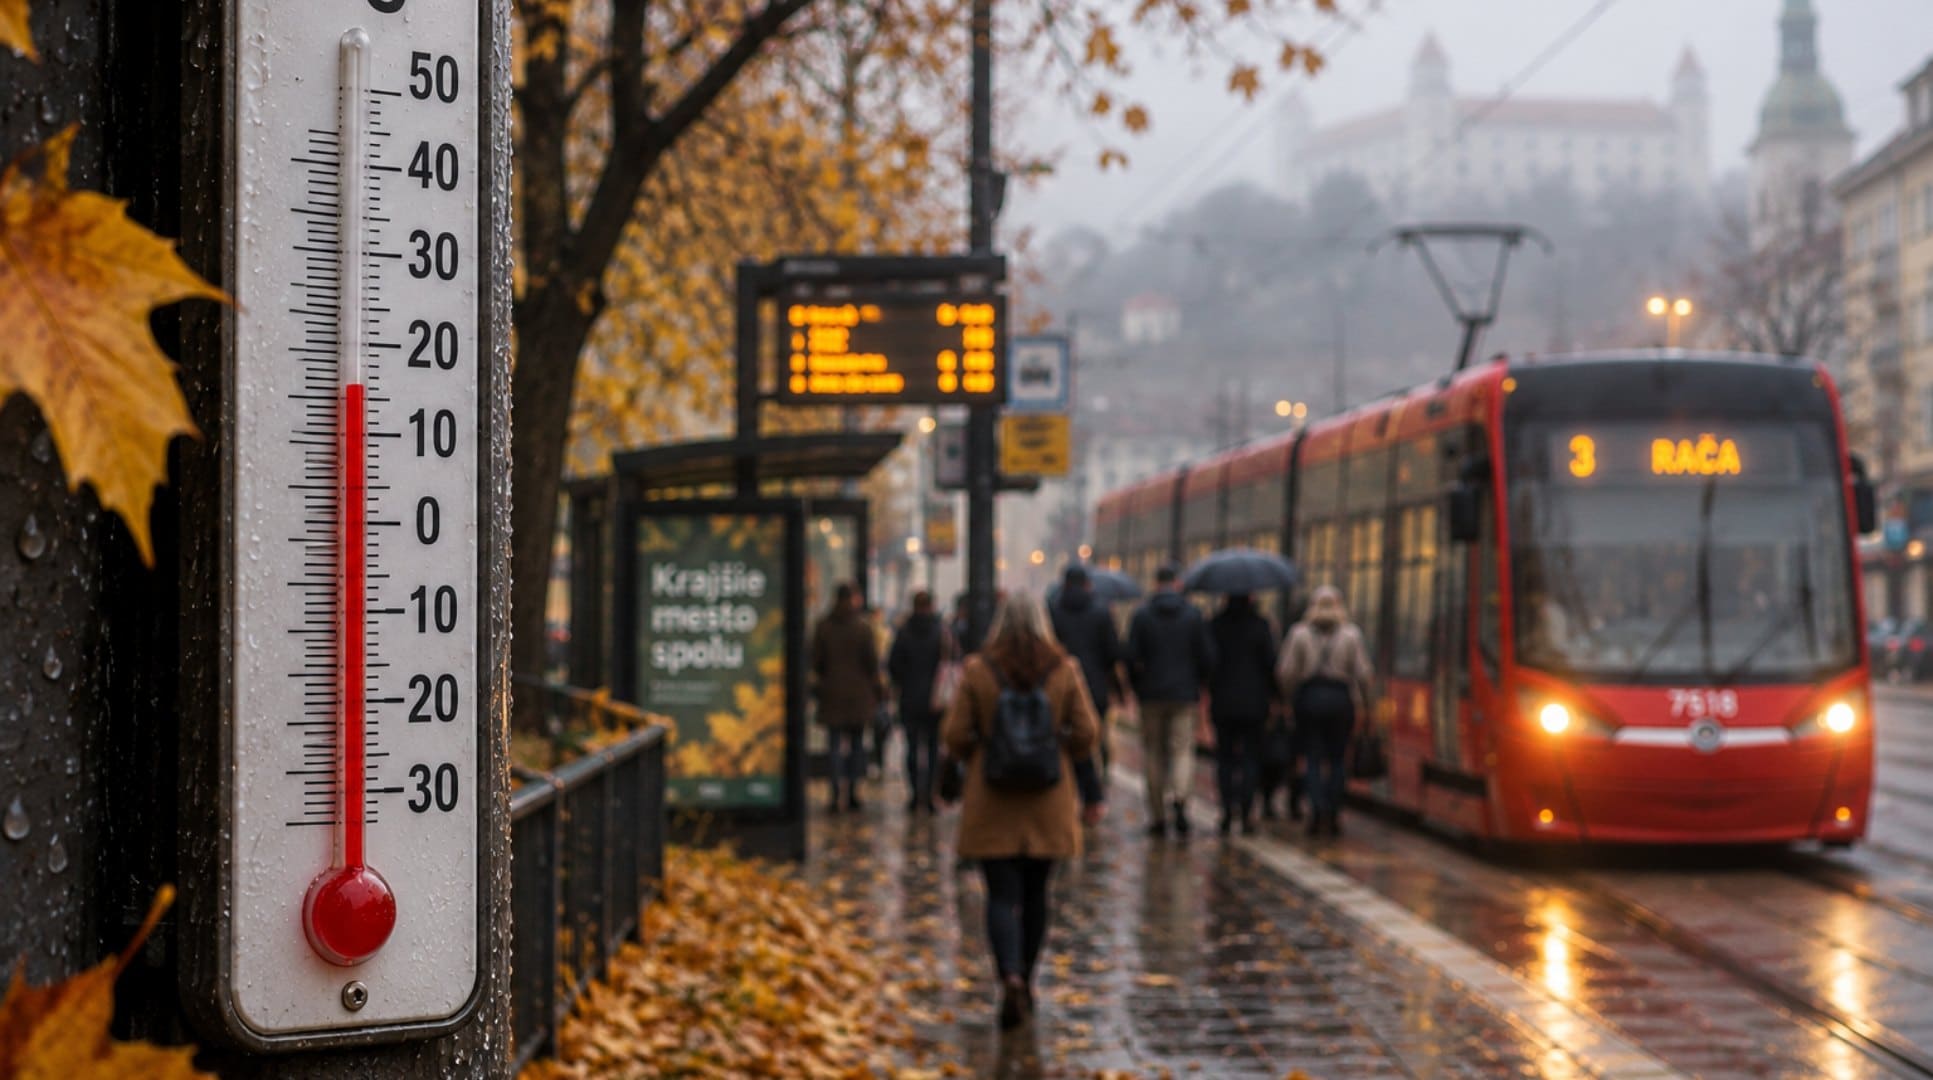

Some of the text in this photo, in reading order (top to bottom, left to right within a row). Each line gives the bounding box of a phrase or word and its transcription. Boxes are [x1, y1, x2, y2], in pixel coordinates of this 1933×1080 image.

[409, 51, 459, 103] 50
[408, 141, 459, 191] 40
[409, 230, 459, 280] 30
[408, 320, 458, 370] 20
[409, 408, 457, 458] 10
[1569, 433, 1741, 477] 3 RAČA
[416, 496, 440, 545] 0
[652, 601, 758, 633] mesto
